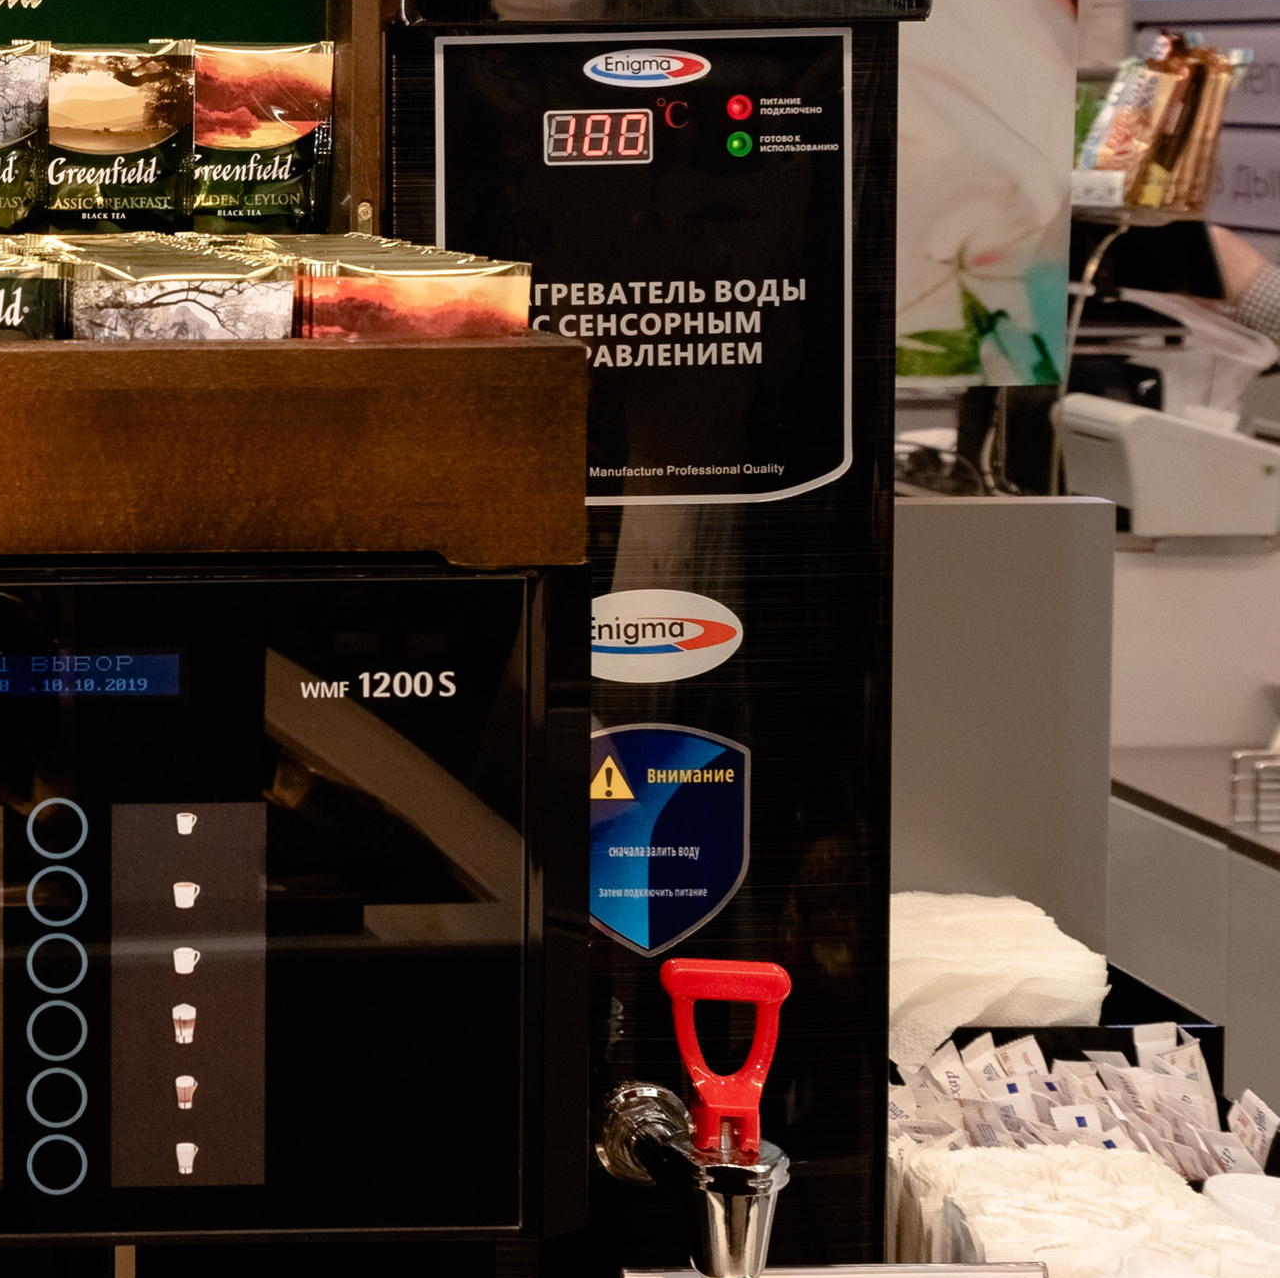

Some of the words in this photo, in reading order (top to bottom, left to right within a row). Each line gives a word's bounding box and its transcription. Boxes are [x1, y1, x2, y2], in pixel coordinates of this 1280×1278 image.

[605, 55, 671, 76] Enigma
[760, 97, 801, 105] ПИТАНИЕ
[760, 107, 822, 116] ПОДКЛЮЧЕНО
[760, 135, 794, 143] ГОТОВО
[760, 144, 839, 152] ИСПОЛЬЗОВАНИЮ
[48, 156, 158, 185] Greenfield
[51, 198, 95, 210] ASSIC
[97, 197, 172, 210] BREAKFAST
[194, 194, 239, 206] OLDEN
[245, 193, 300, 206] CEYLON
[529, 279, 706, 306] ГРЕВАТЕЛЬ
[714, 278, 807, 307] ВОДЫ
[559, 311, 762, 337] СЕНСОРНЫМ
[586, 342, 763, 367] АВЛЕНИЕМ
[589, 464, 663, 477] Manufacture
[667, 463, 739, 476] Professional
[743, 462, 785, 477] Quality
[590, 617, 684, 645] Enigma
[31, 655, 133, 672] ВЫБОР
[300, 679, 350, 698] WMF
[647, 767, 734, 784] Внимание
[608, 846, 644, 857] сначала
[646, 846, 676, 857] залить
[678, 846, 700, 860] воду
[599, 887, 622, 897] Затем
[624, 888, 673, 899] подключить
[675, 888, 707, 897] питание
